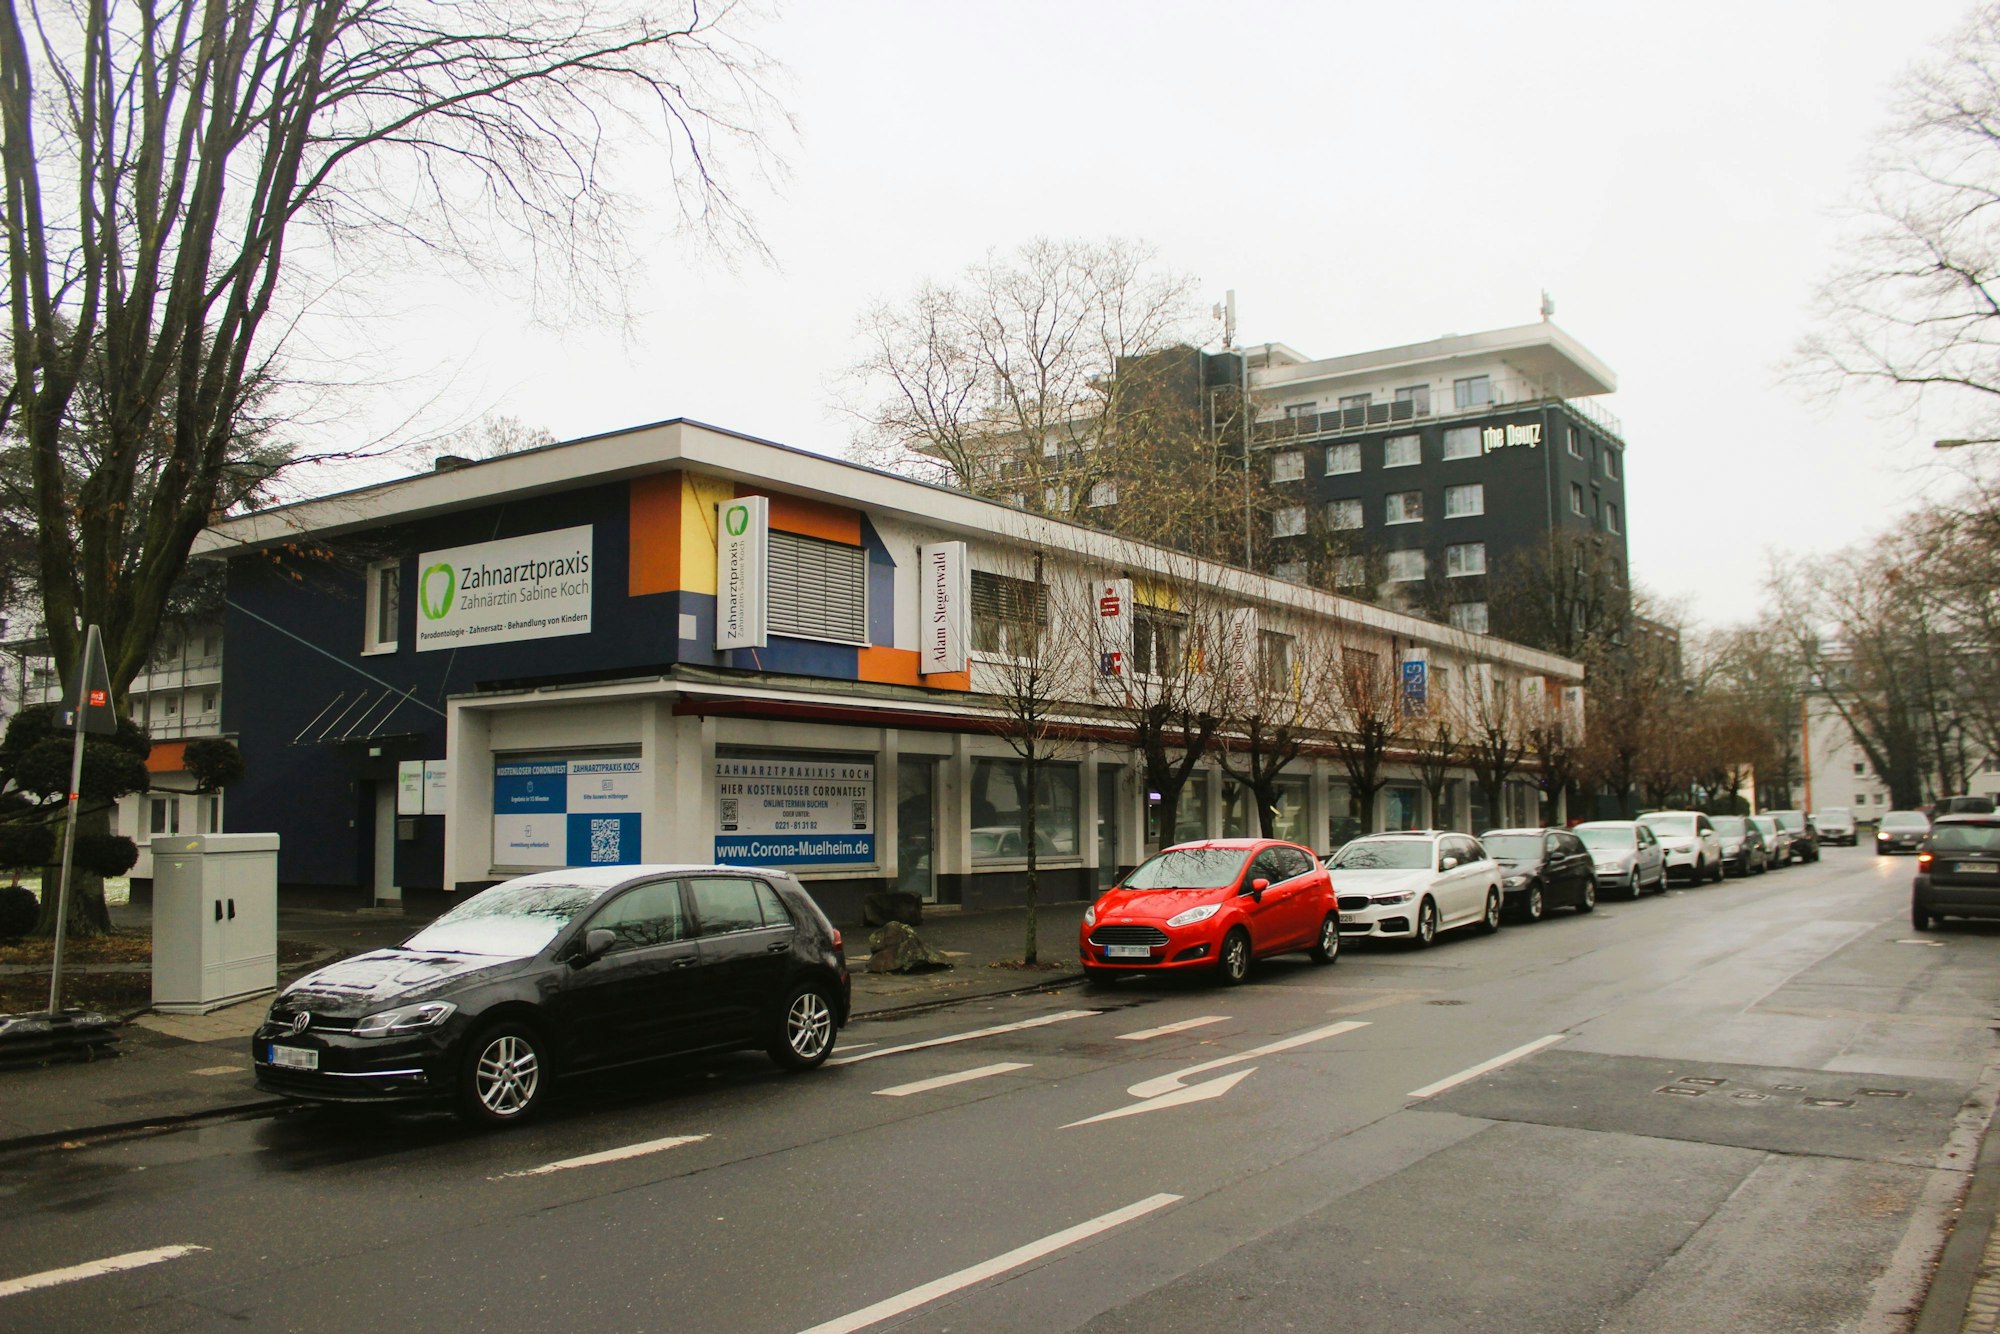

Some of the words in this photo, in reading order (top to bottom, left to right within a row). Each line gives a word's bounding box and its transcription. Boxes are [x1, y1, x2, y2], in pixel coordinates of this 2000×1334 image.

[460, 550, 589, 590] Zahnarztpraxis
[460, 591, 517, 611] Zahnärztin
[519, 585, 558, 603] Sabine
[560, 578, 589, 597] Koch
[727, 541, 740, 639] Zahnarztpraxis
[933, 552, 949, 623] Stegerwald
[420, 628, 465, 640] Parodontologie
[469, 624, 503, 635] Zahnersatz
[507, 618, 546, 630] Behandlung
[548, 617, 560, 625] von
[561, 613, 588, 623] Kindern
[933, 627, 947, 662] Adam
[496, 766, 532, 776] KOSTENLOSER
[532, 765, 567, 775] CORONATEST
[573, 763, 622, 773] ZAHNARZTPRAXIS
[623, 762, 640, 771] KOCH
[842, 768, 869, 779] KOCH
[721, 783, 743, 795] HIER
[747, 784, 810, 797] KOSTENLOSER
[812, 785, 866, 797] CORONATEST
[763, 799, 785, 808] ONLINE
[785, 800, 806, 808] TERMIN
[774, 821, 790, 830] 0221
[793, 821, 801, 830] 81
[801, 821, 809, 830] 31
[716, 840, 869, 858] www.Corona-Muelheim.de
